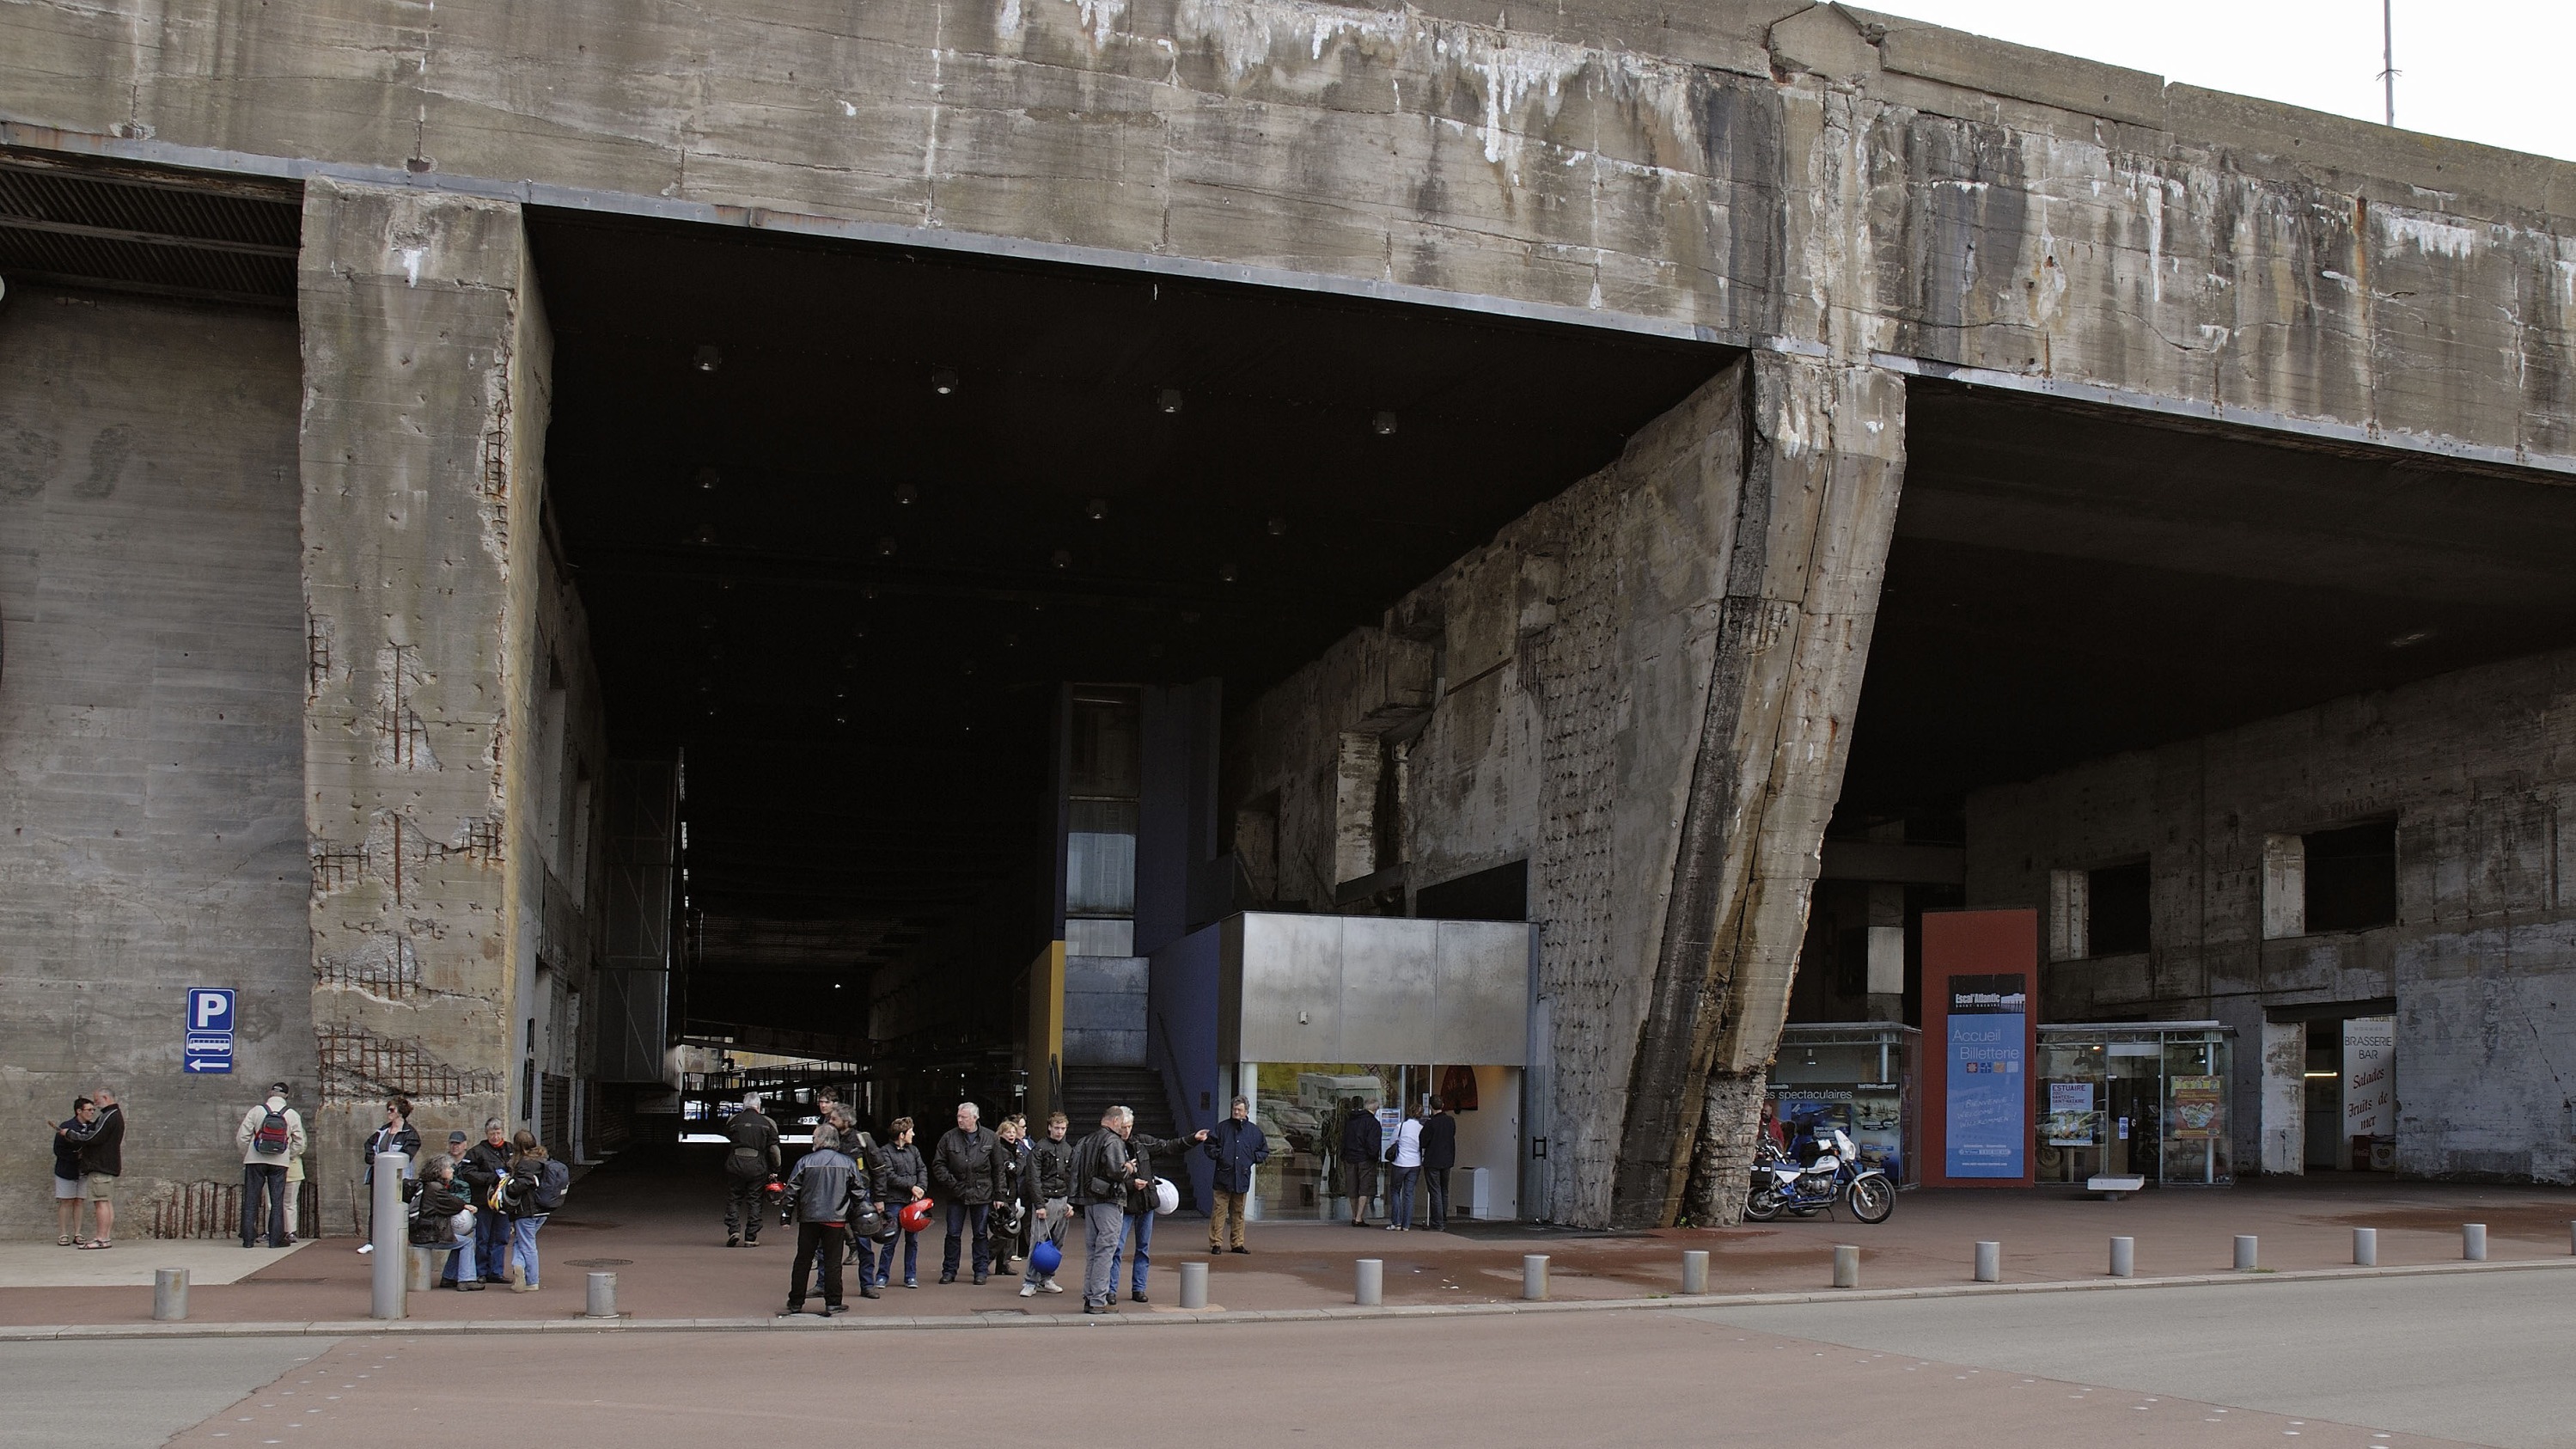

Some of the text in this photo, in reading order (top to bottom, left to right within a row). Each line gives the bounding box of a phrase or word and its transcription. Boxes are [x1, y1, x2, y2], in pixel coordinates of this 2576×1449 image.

[197, 993, 228, 1027] P
[1952, 1029, 2000, 1042] Accueil
[2344, 1036, 2392, 1047] BRASSERIE
[1960, 1046, 2020, 1060] Billetterie
[2359, 1049, 2378, 1060] BAR
[2353, 1068, 2384, 1089] Salades
[1778, 1089, 1853, 1101] spectaculaires
[2348, 1091, 2388, 1118] Fruits de
[2360, 1115, 2377, 1130] mer
